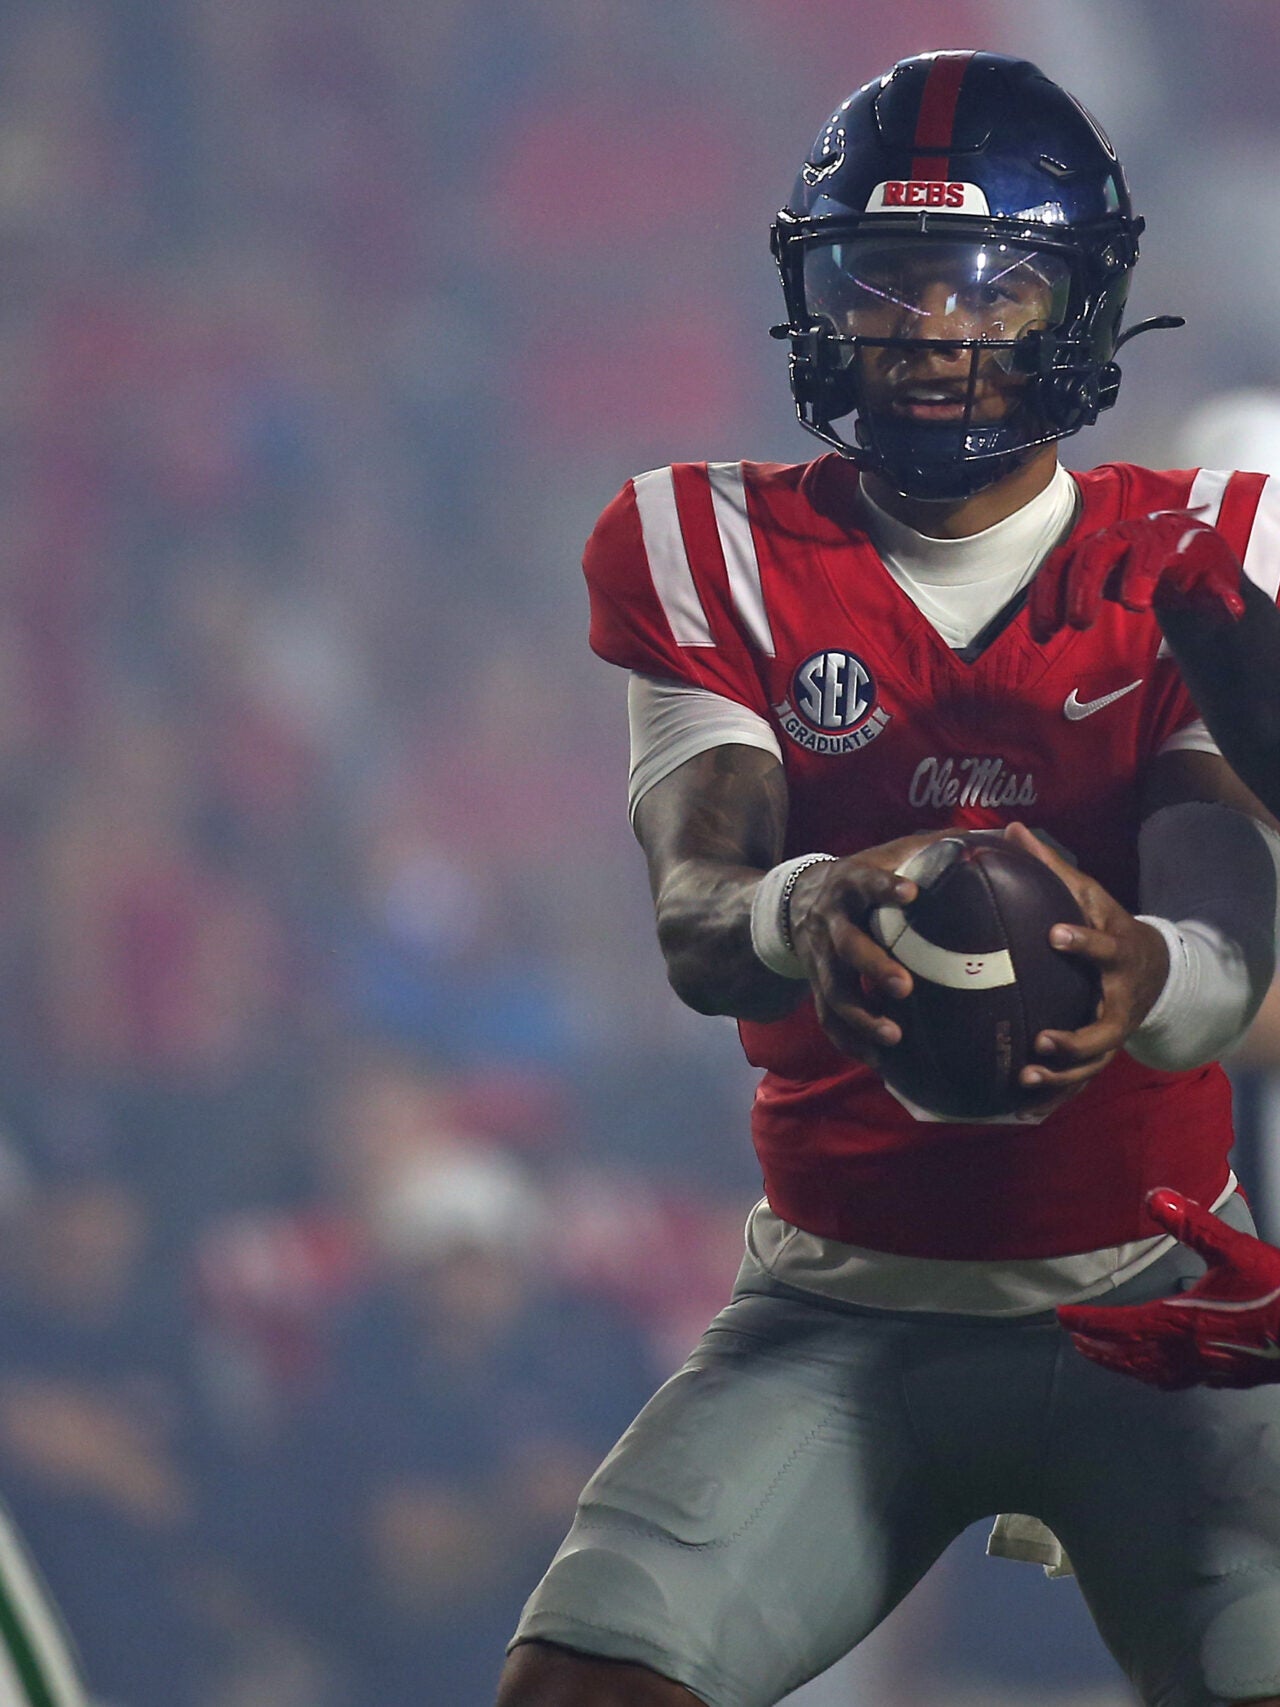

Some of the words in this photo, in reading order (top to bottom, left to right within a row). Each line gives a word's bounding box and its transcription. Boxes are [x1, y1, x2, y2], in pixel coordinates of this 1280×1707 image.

[882, 182, 964, 207] REBS
[798, 652, 870, 727] SEC
[785, 717, 876, 753] GRADUATE
[908, 756, 960, 809] Ole
[959, 757, 1039, 808] Miss
